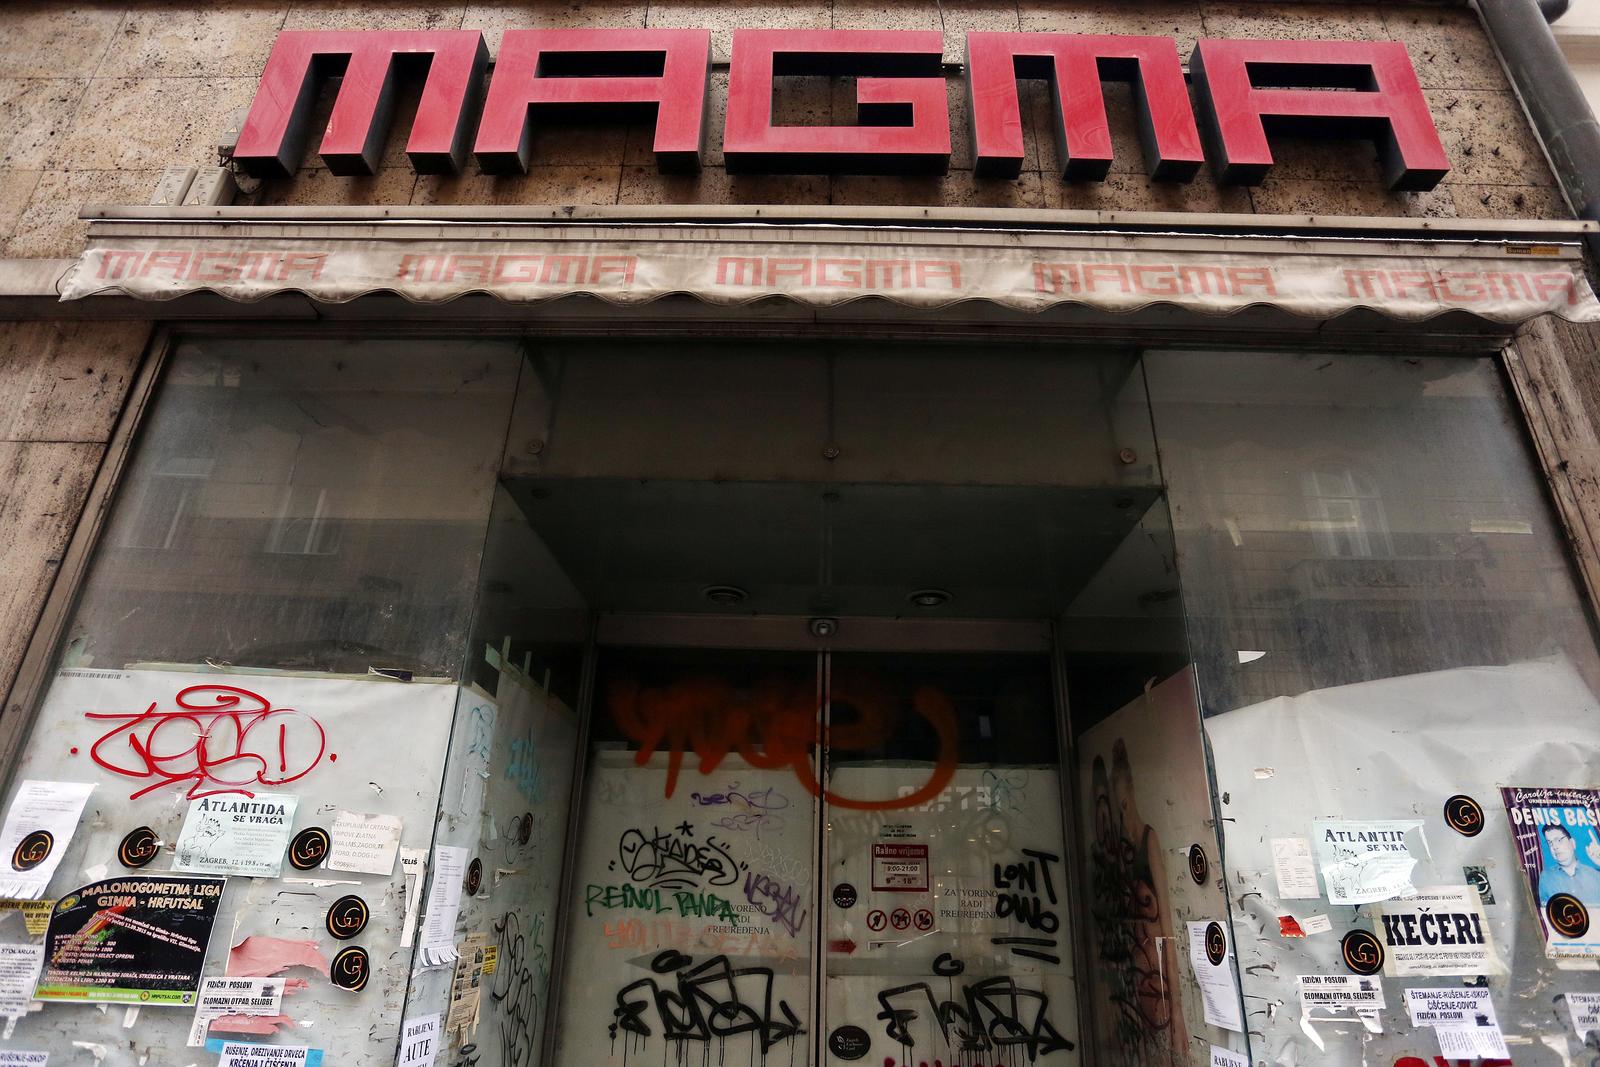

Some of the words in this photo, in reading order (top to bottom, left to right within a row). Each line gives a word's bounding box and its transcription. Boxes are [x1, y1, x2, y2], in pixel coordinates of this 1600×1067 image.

[233, 28, 1451, 191] MAGMA
[96, 250, 329, 281] MAGMA
[398, 254, 638, 285] MAGMA
[715, 256, 961, 289] MAGMA
[1033, 262, 1278, 296] MAGMA
[1344, 269, 1578, 305] MAGMA
[198, 798, 285, 815] ATLANTIDA
[1511, 807, 1560, 825] DENIS
[248, 815, 284, 825] VRAĆA
[898, 847, 925, 857] vrijeme
[82, 882, 191, 898] MALONOGOMETNA
[193, 884, 221, 896] LIGA
[97, 896, 136, 907] GIMKA
[147, 897, 204, 909] HRFUTSAL
[960, 900, 983, 909] RADI
[1381, 907, 1485, 946] KEČERI
[224, 1045, 249, 1058] RUŠENJE,
[250, 1047, 284, 1058] OREZIVANJE
[404, 1038, 431, 1064] AUTE
